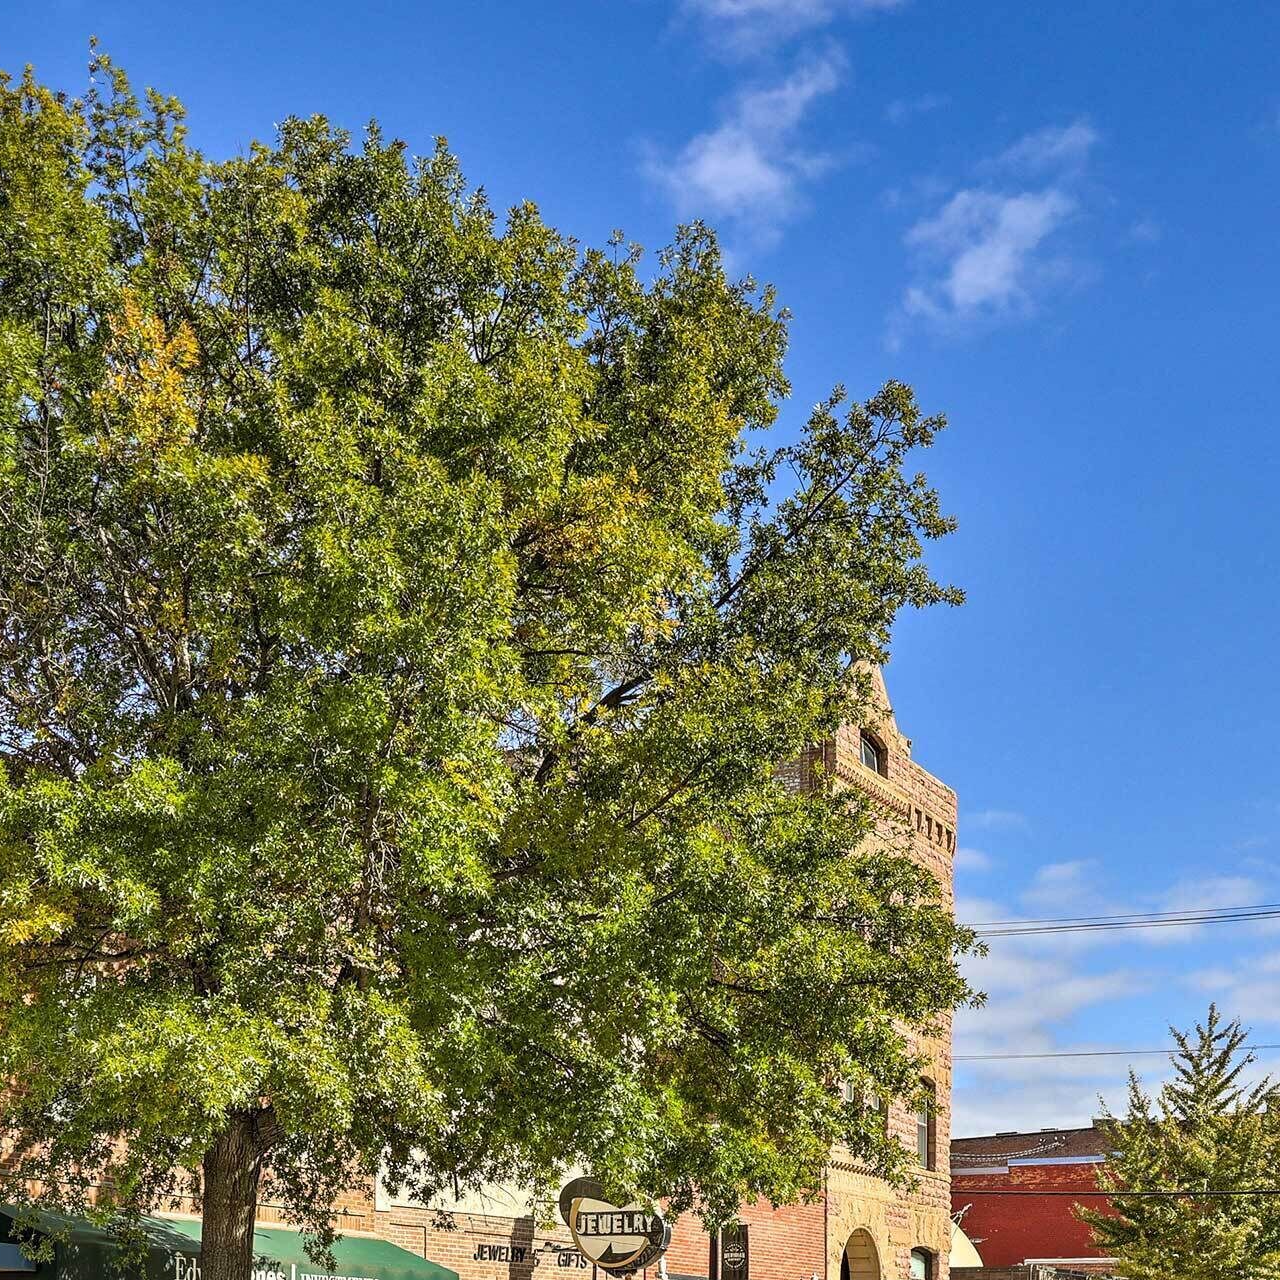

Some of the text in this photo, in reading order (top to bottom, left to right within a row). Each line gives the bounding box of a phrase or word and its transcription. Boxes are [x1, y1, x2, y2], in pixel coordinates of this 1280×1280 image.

[575, 1213, 655, 1235] JEWELRY
[473, 1244, 527, 1263] JEWELRY
[557, 1252, 588, 1270] GIFTS
